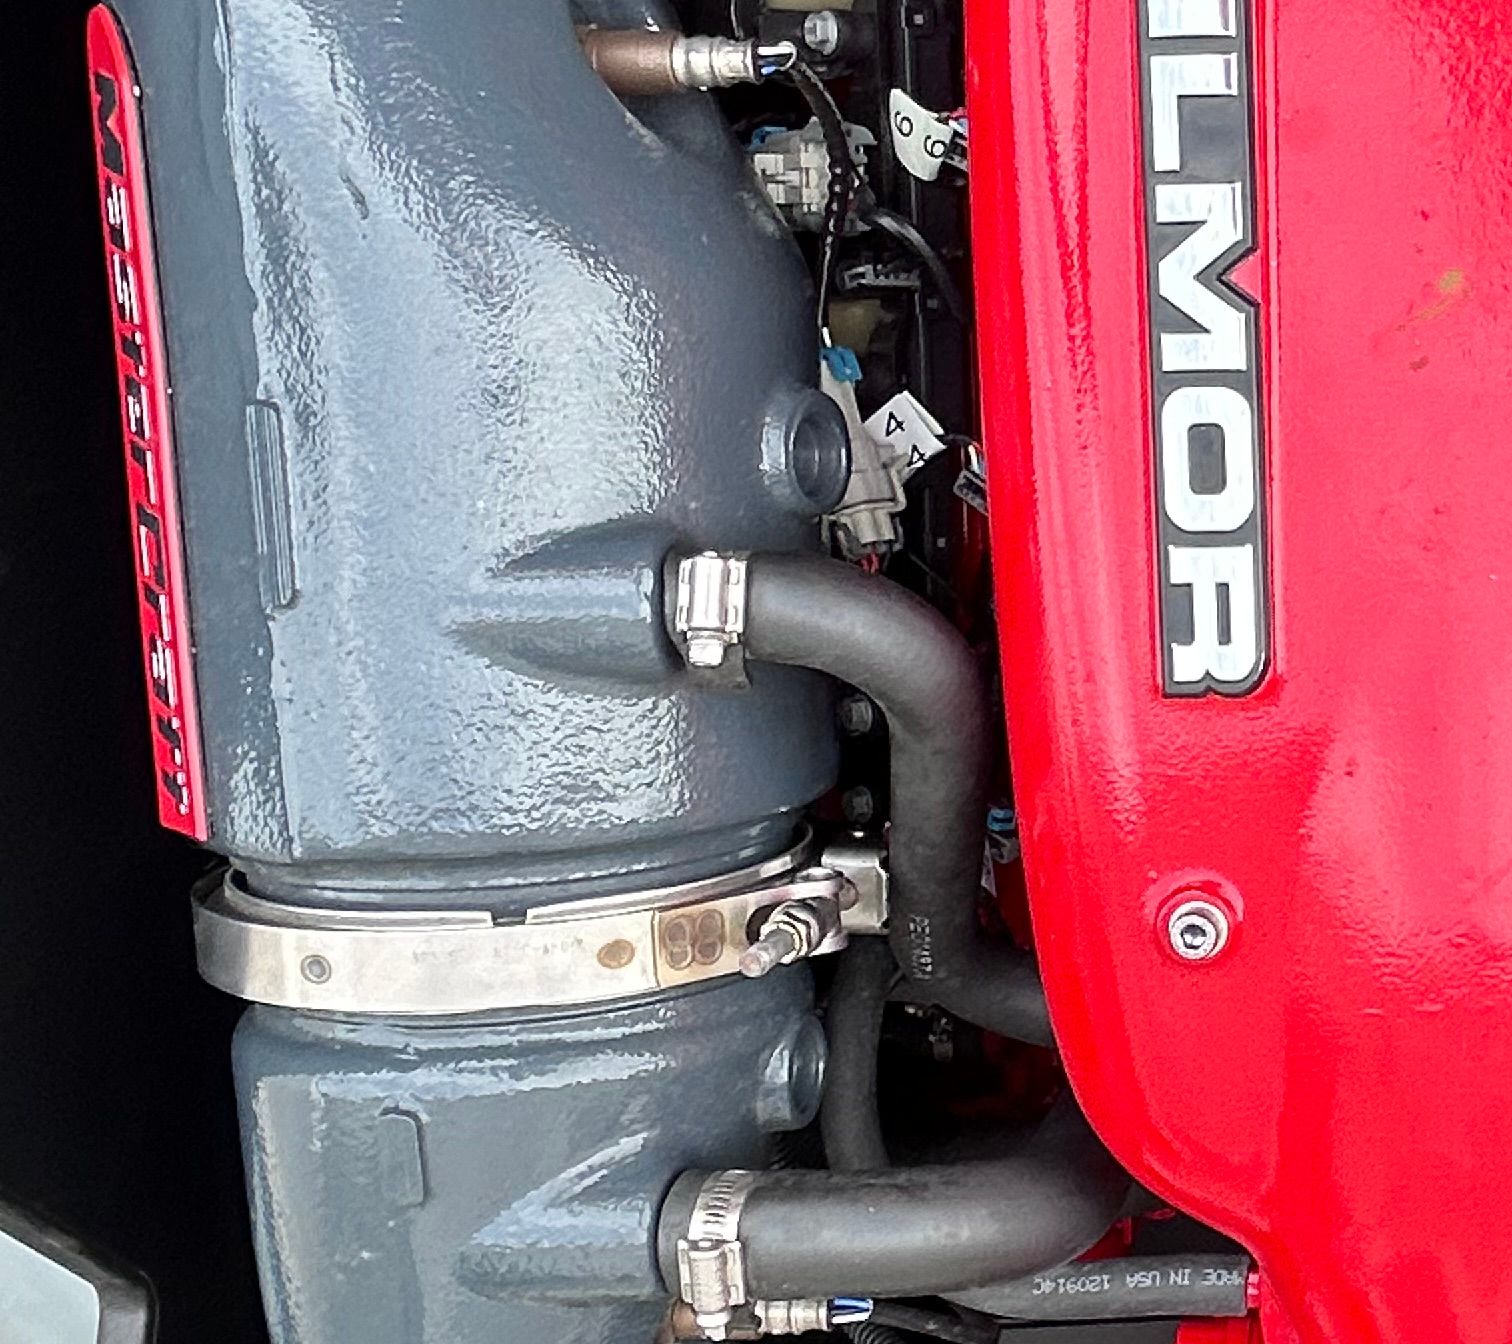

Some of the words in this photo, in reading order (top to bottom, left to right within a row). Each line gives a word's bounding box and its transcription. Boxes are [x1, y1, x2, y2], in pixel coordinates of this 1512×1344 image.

[885, 410, 906, 438] 4
[906, 444, 926, 468] 4
[1032, 1274, 1111, 1295] 120914C
[1126, 1270, 1161, 1288] USA
[1169, 1268, 1192, 1286] IN
[1201, 1268, 1245, 1286] MADE
